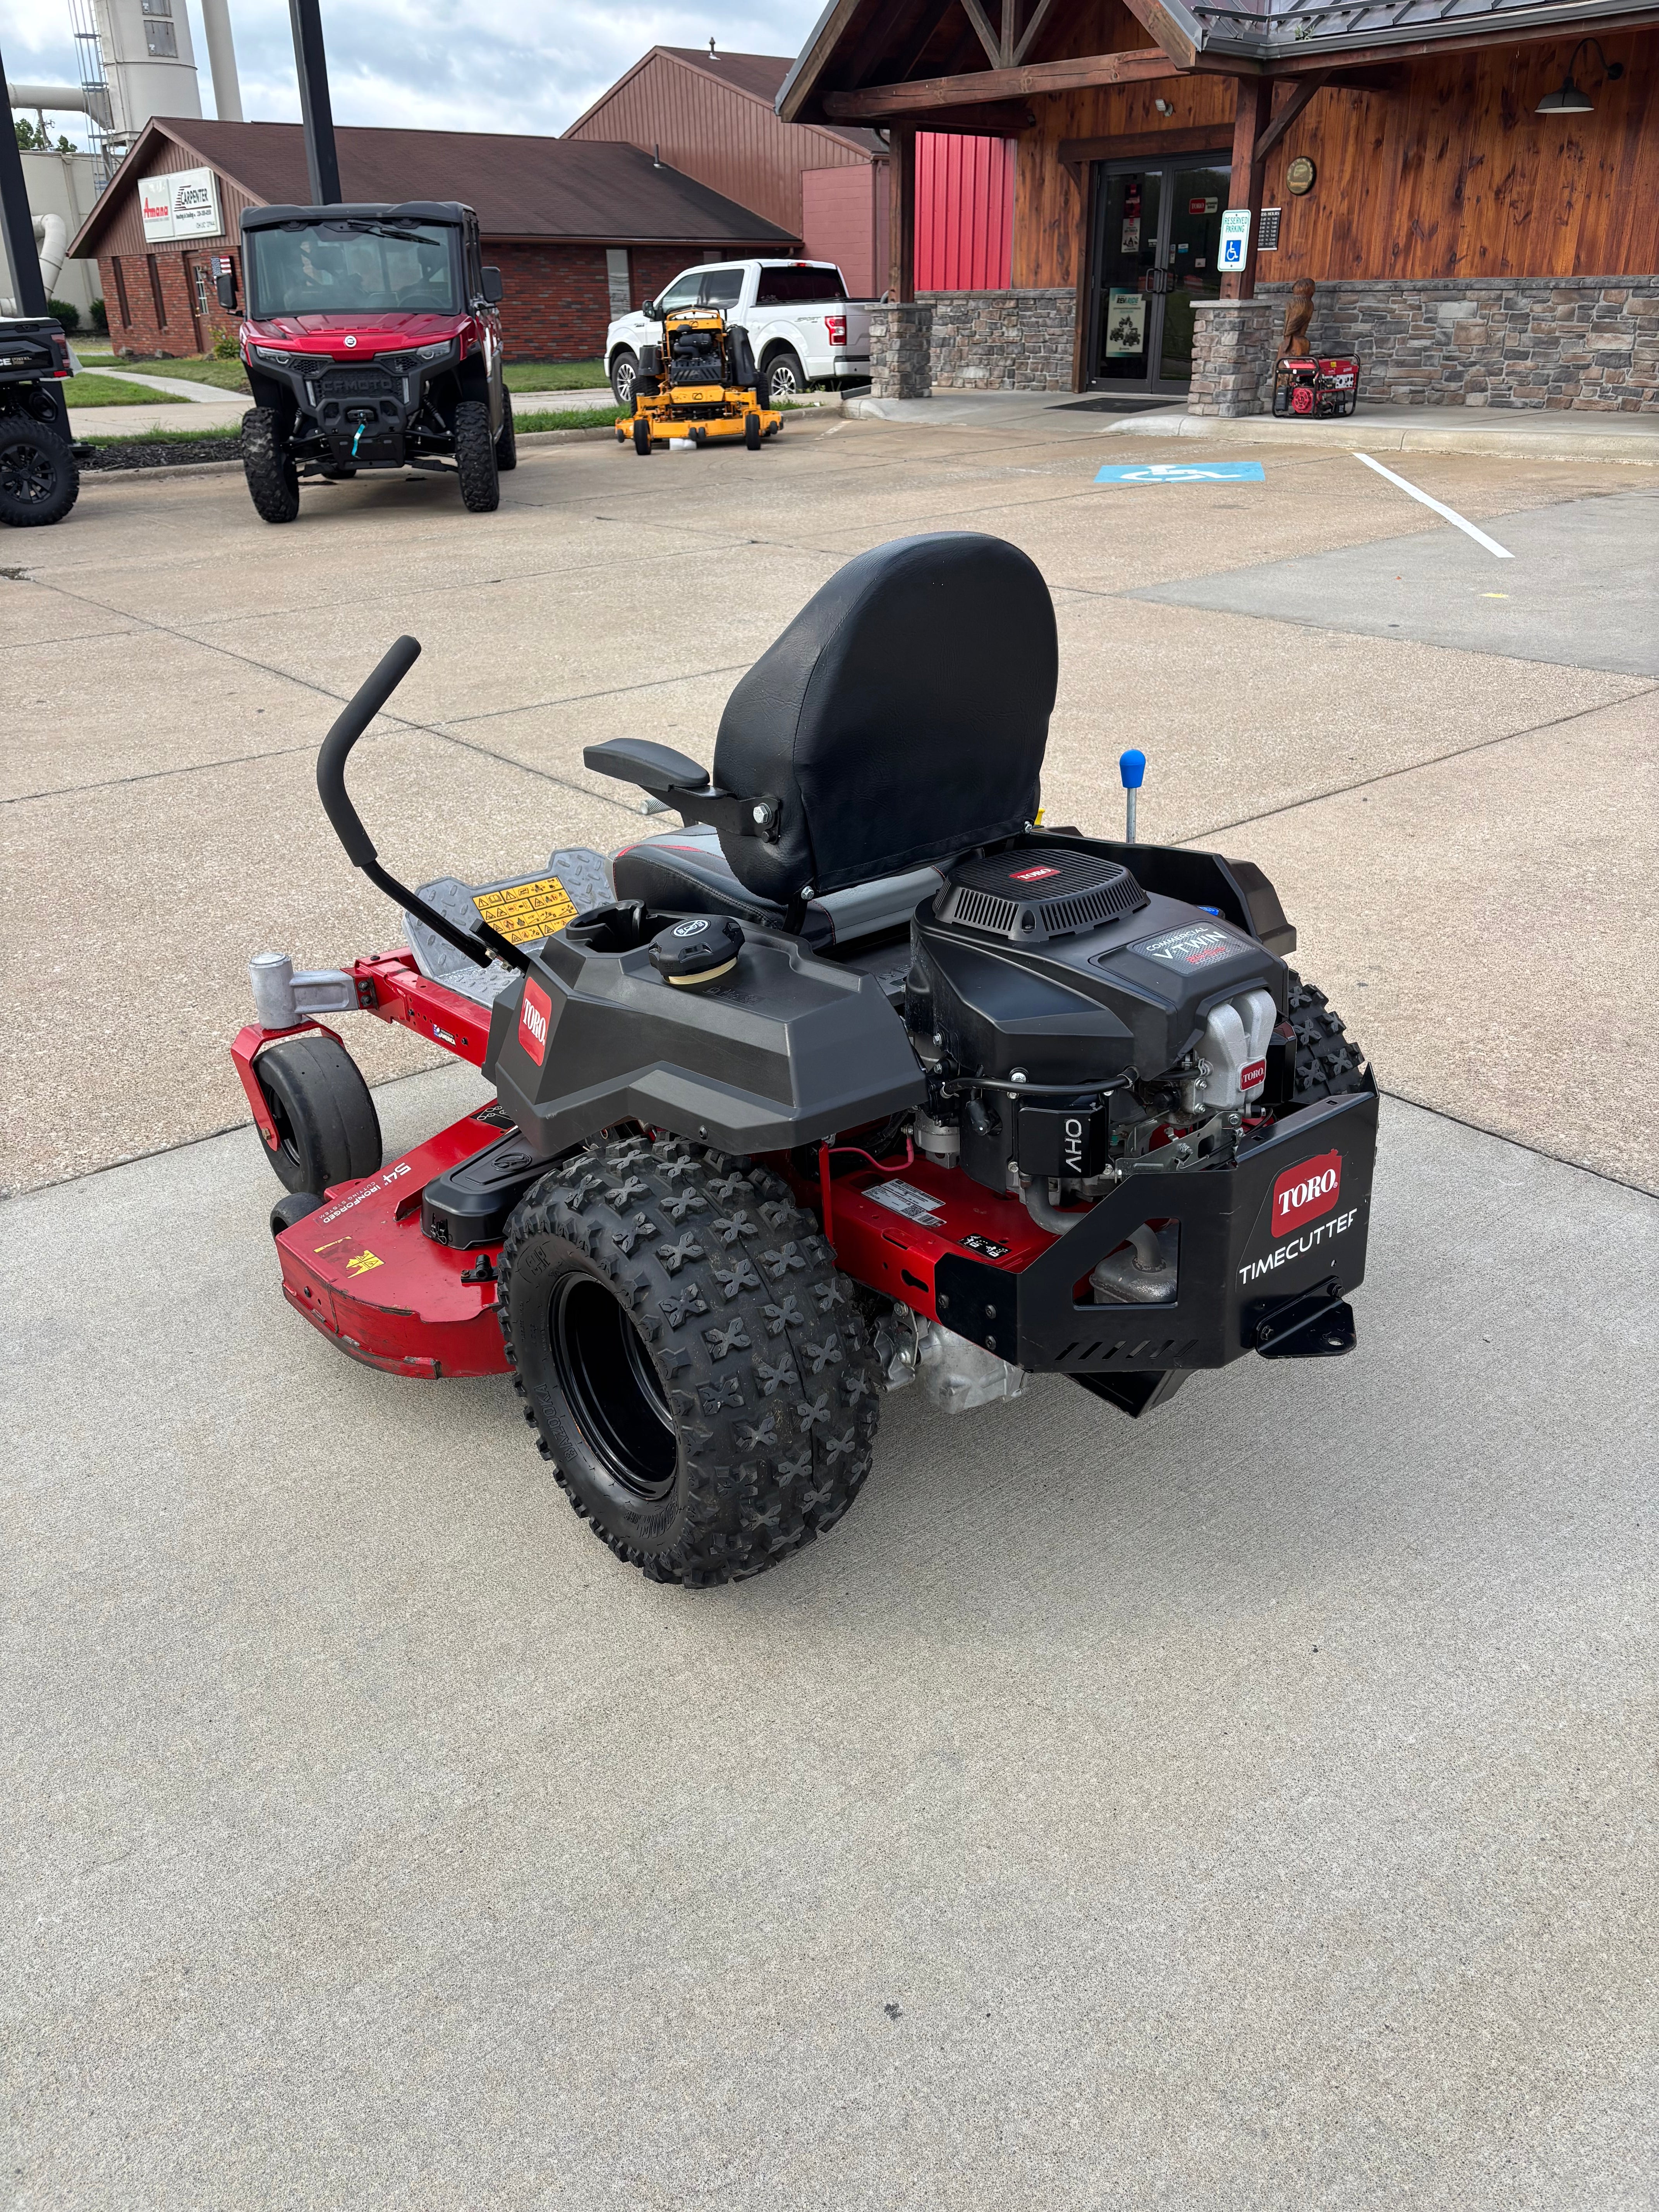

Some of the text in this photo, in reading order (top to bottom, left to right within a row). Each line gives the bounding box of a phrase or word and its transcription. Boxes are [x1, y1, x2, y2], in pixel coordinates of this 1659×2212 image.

[143, 197, 168, 218] Amana
[180, 188, 208, 204] CARPENTER
[322, 379, 392, 391] CFMOTO
[1017, 869, 1051, 879] TORO
[1146, 927, 1209, 951] COMMERCIAL
[523, 998, 546, 1043] TORO
[1243, 1067, 1264, 1083] TORO
[1065, 1119, 1082, 1173] OHV
[319, 1182, 376, 1219] CUTTING SYSTEM
[323, 1185, 381, 1223] IRONFORGED
[1278, 1169, 1336, 1216] TORO
[534, 1383, 578, 1462] BAZOOKA
